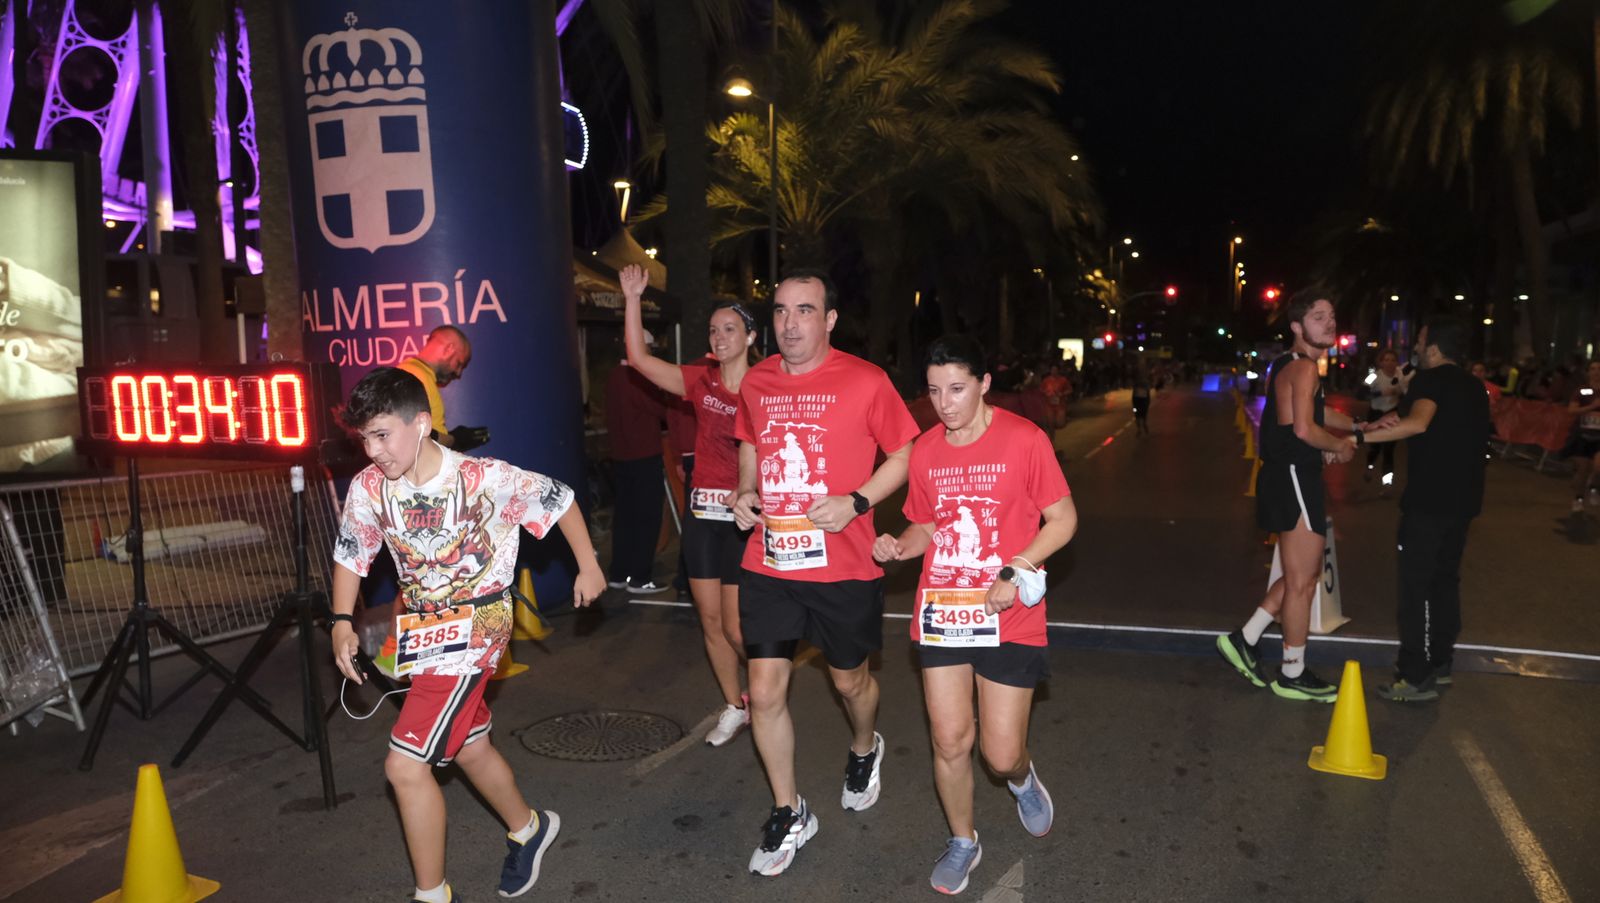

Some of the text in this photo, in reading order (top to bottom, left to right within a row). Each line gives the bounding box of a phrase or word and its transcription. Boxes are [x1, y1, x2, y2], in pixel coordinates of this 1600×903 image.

[303, 269, 508, 332] ALMERÍA
[329, 334, 430, 367] CIUDA
[765, 396, 793, 405] CARRERA
[797, 394, 836, 403] BOMBEROS
[798, 403, 826, 411] CIUDAD
[112, 374, 305, 446] 00:34:10
[933, 467, 963, 477] CARRERA
[968, 464, 1006, 474] BOMBEROS
[969, 475, 997, 483] CIUDAD
[700, 492, 726, 504] 310
[403, 506, 444, 529] Tuff
[935, 609, 985, 625] 3496
[409, 625, 459, 650] 3585
